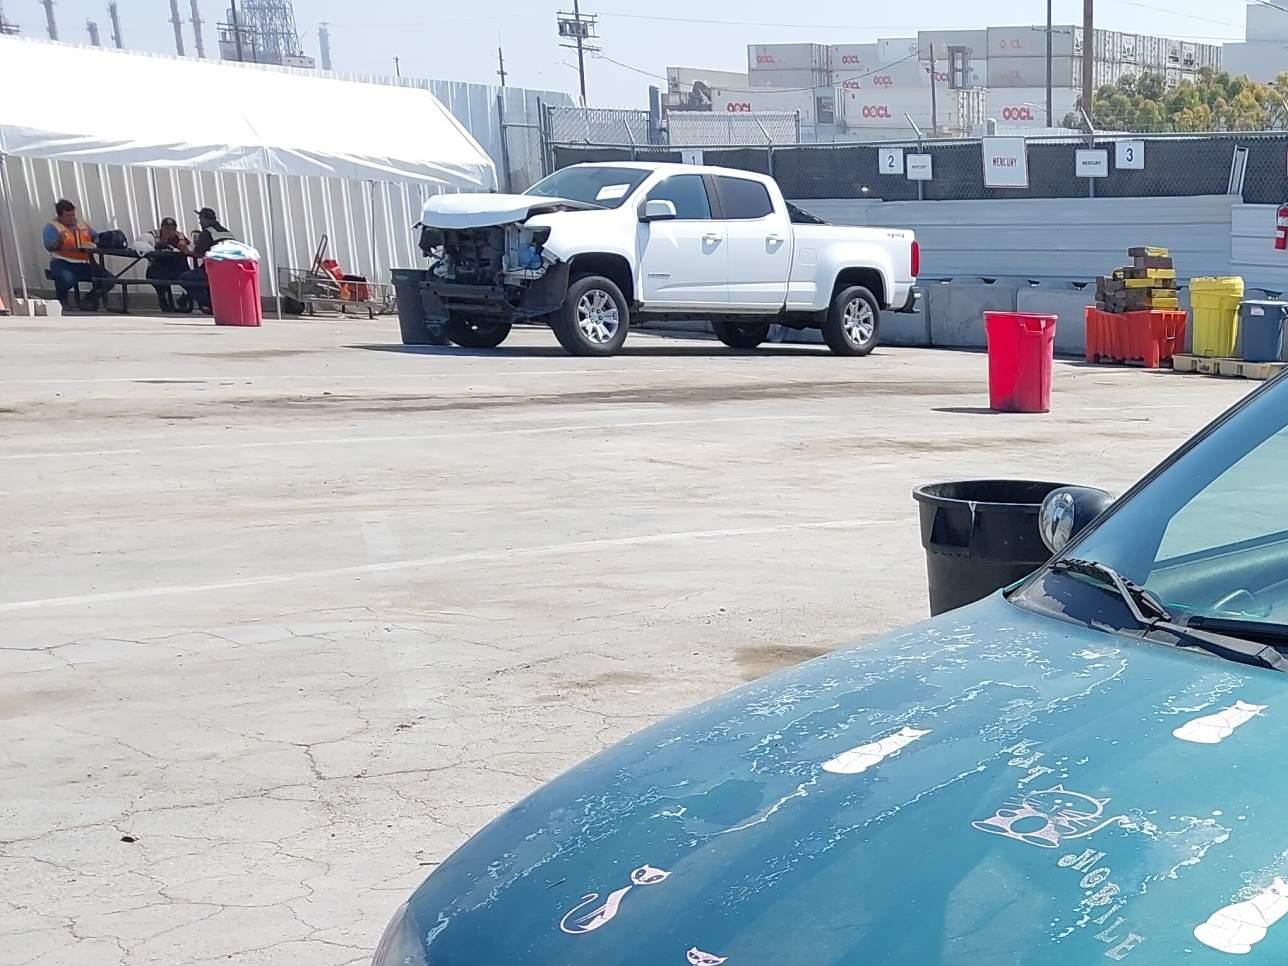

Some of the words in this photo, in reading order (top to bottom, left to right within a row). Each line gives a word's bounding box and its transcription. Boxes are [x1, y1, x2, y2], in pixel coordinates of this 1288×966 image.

[842, 55, 861, 64] OOCL
[873, 76, 893, 85] OOCL
[862, 106, 892, 118] OOCL
[1003, 107, 1034, 120] OOCL
[888, 154, 895, 168] 2
[1126, 148, 1134, 162] 3
[992, 157, 1017, 168] MERCURY
